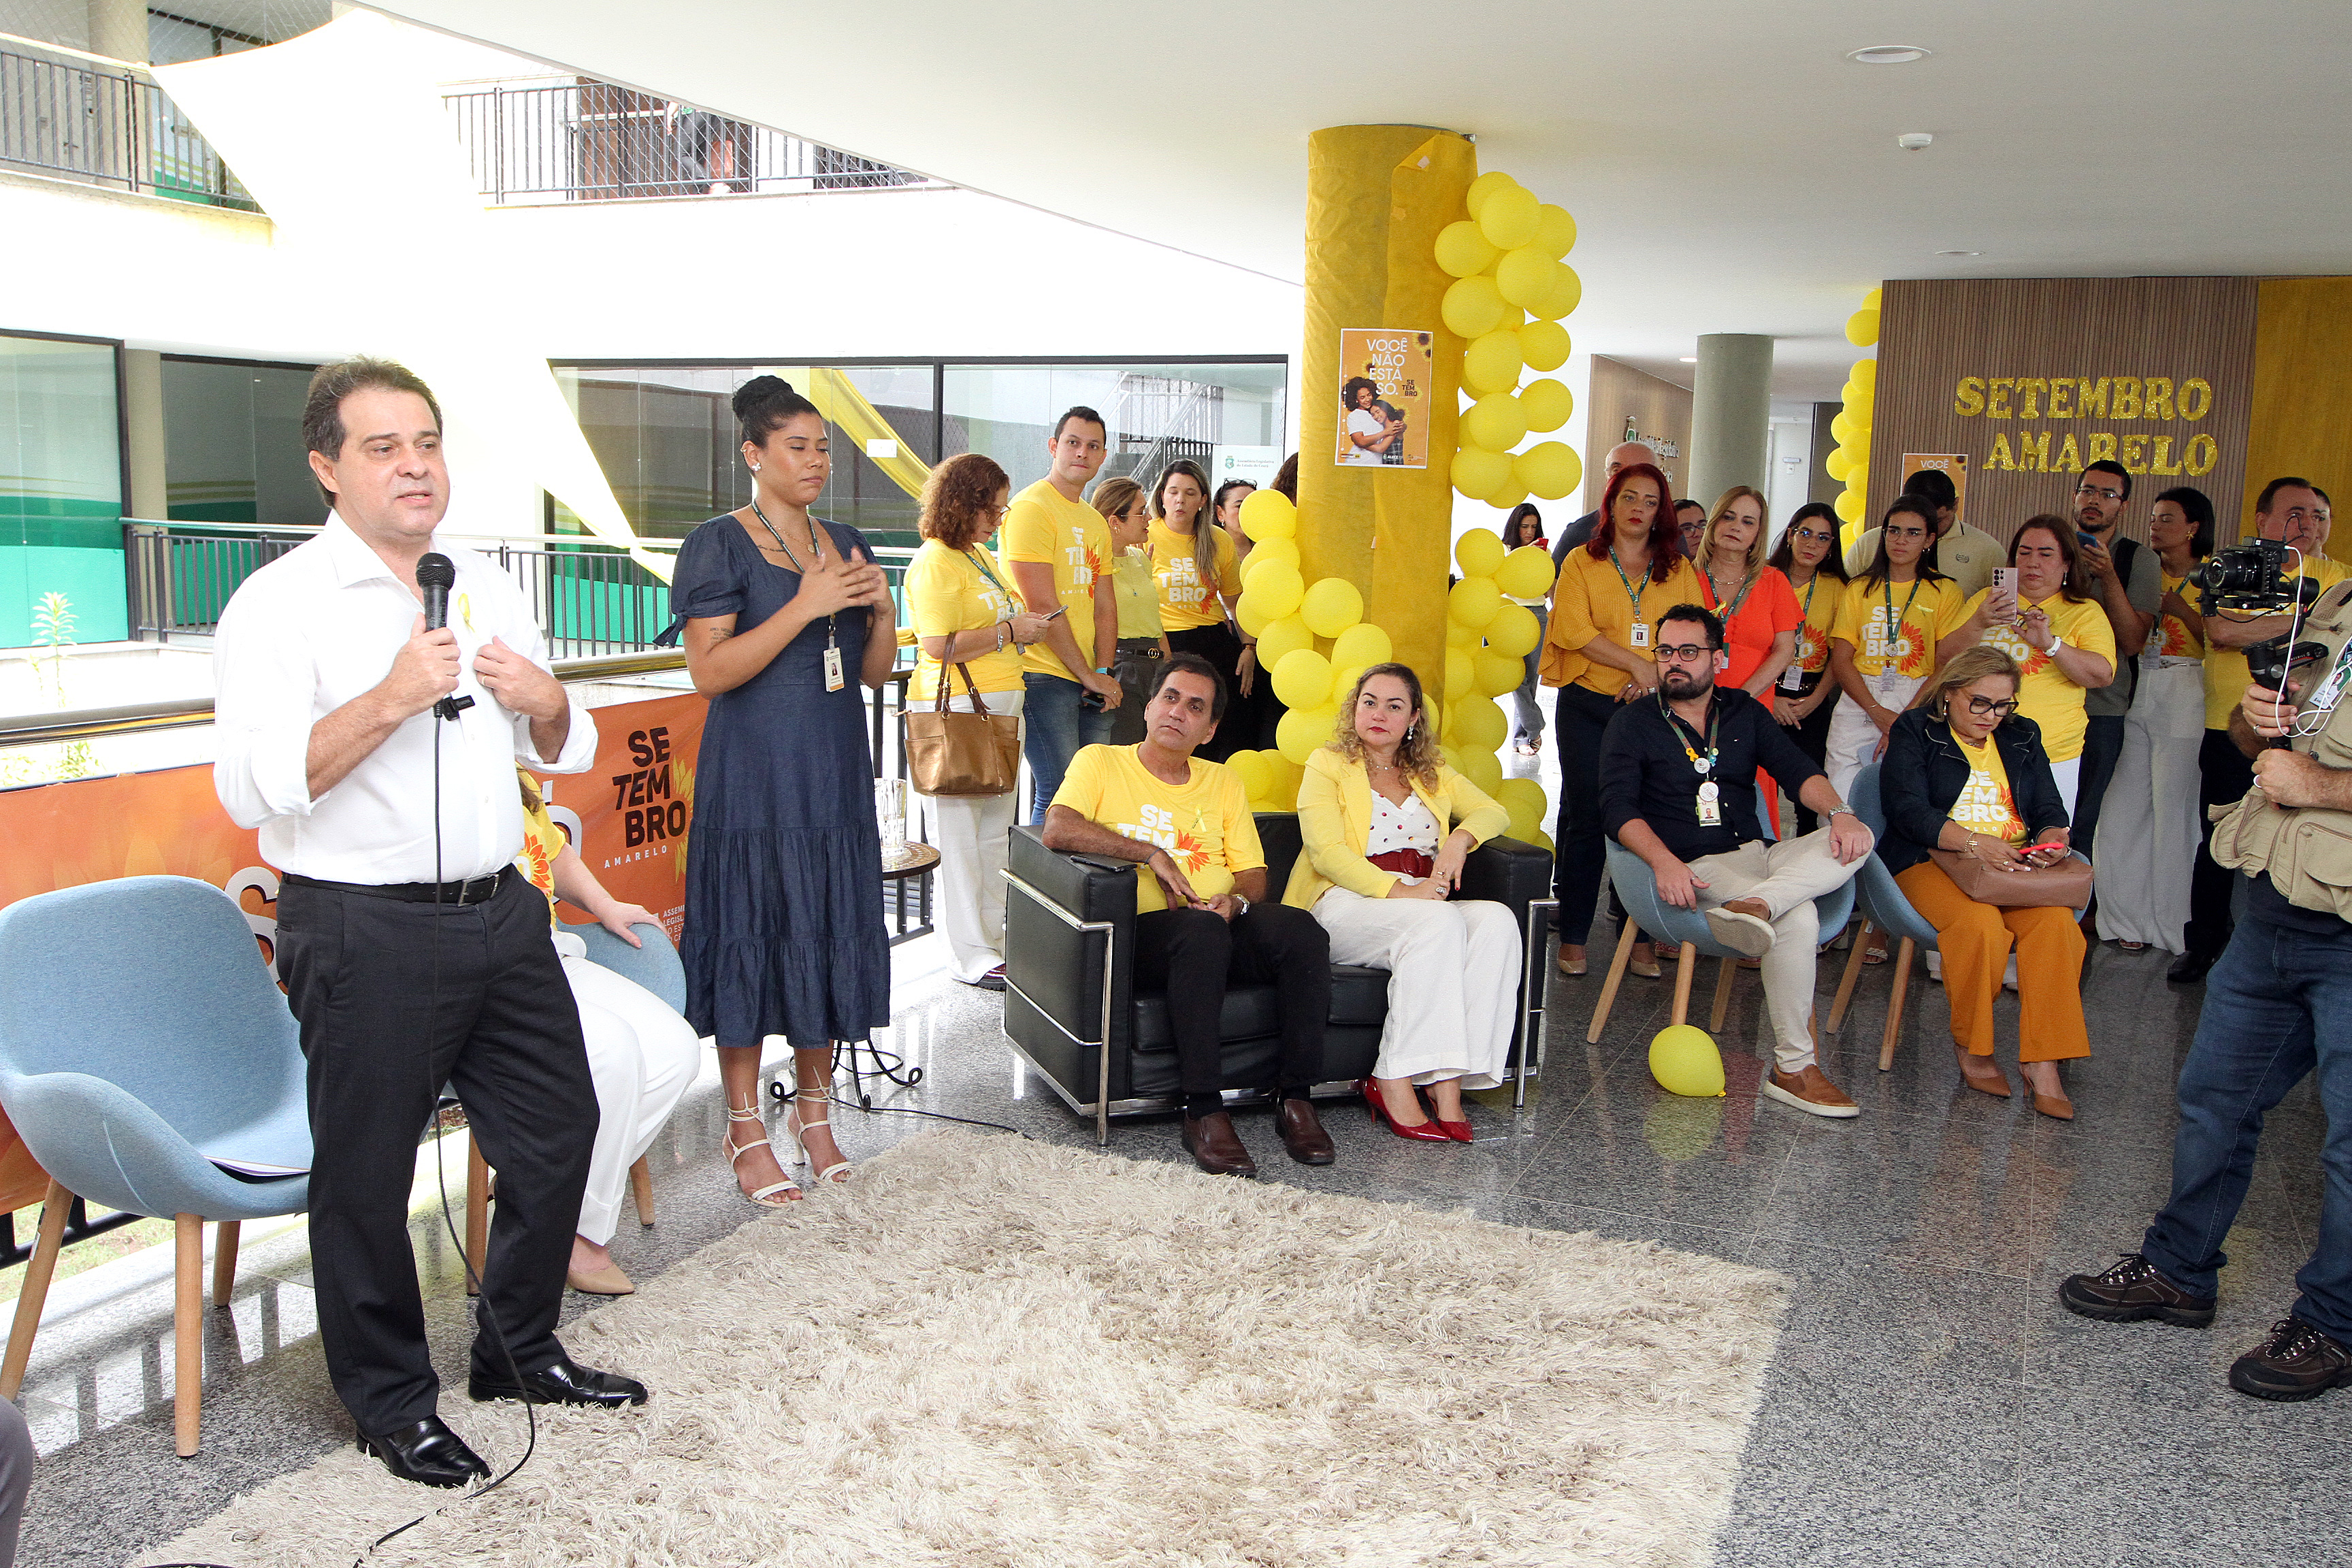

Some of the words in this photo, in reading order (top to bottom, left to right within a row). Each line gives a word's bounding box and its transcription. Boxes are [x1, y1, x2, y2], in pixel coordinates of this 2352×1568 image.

[1367, 338, 1408, 353] VOCÊ
[1372, 352, 1405, 367] NÃO
[1369, 366, 1402, 381] ESTÁ
[1375, 380, 1399, 395] SÓ.
[1955, 376, 2212, 421] SETEMBRO
[1982, 431, 2219, 477] AMARELO
[1921, 459, 1949, 469] VOCÊ
[1170, 557, 1195, 572] SE
[1158, 572, 1199, 588] TEM
[1169, 587, 1207, 602] BRO
[628, 726, 670, 768] SE
[612, 764, 670, 811] TEM
[1955, 786, 1997, 805] EM
[624, 800, 686, 848] BRO
[1140, 804, 1174, 832] SE
[1117, 823, 1175, 849] TEM
[604, 845, 668, 869] AMARELO
[663, 904, 685, 917] ASSEM
[663, 915, 685, 927] LEGISL
